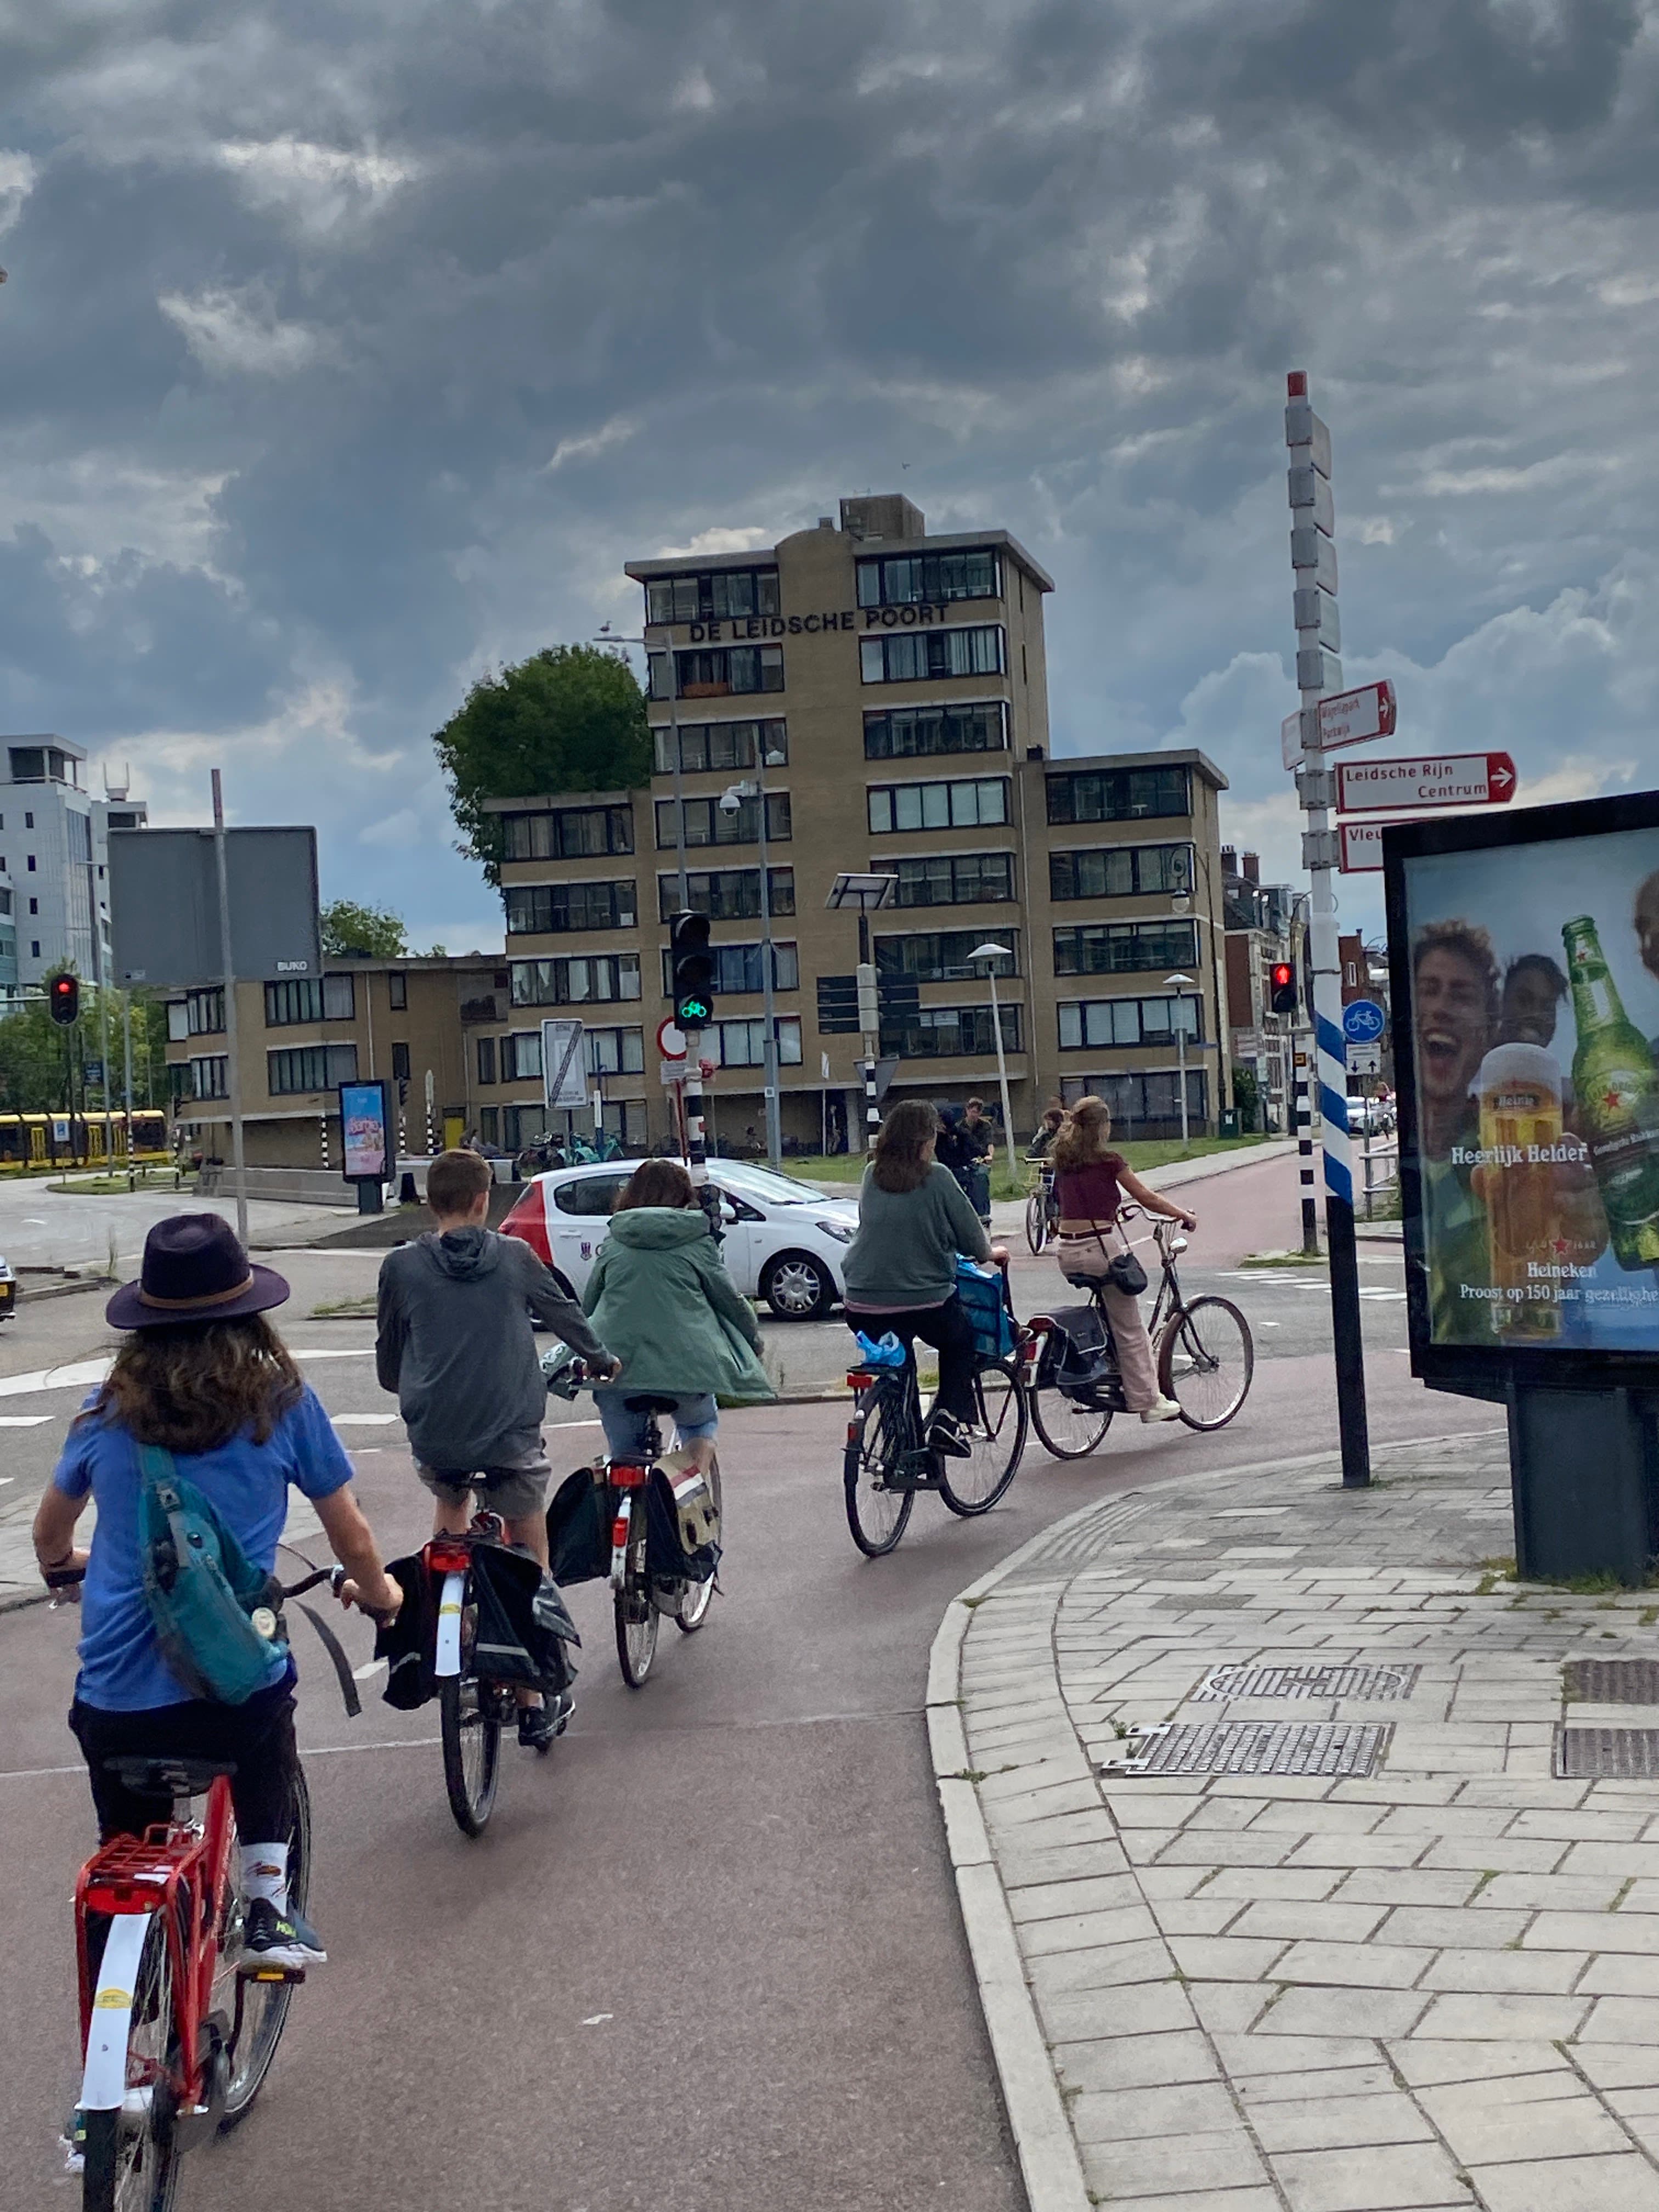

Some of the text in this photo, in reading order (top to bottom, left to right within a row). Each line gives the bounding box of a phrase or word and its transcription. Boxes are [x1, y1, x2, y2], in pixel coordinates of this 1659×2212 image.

[691, 605, 949, 642] DE LEIDSCHE POORT
[1346, 763, 1453, 782] Leidsche Rijn
[1418, 784, 1487, 798] Centrum
[1452, 1144, 1588, 1167] Heerlijk Helder
[1527, 1262, 1599, 1278] Heineken
[1460, 1284, 1503, 1300] Proost
[1508, 1287, 1523, 1304] op
[1526, 1285, 1550, 1299] 150
[1553, 1286, 1581, 1303] jaar
